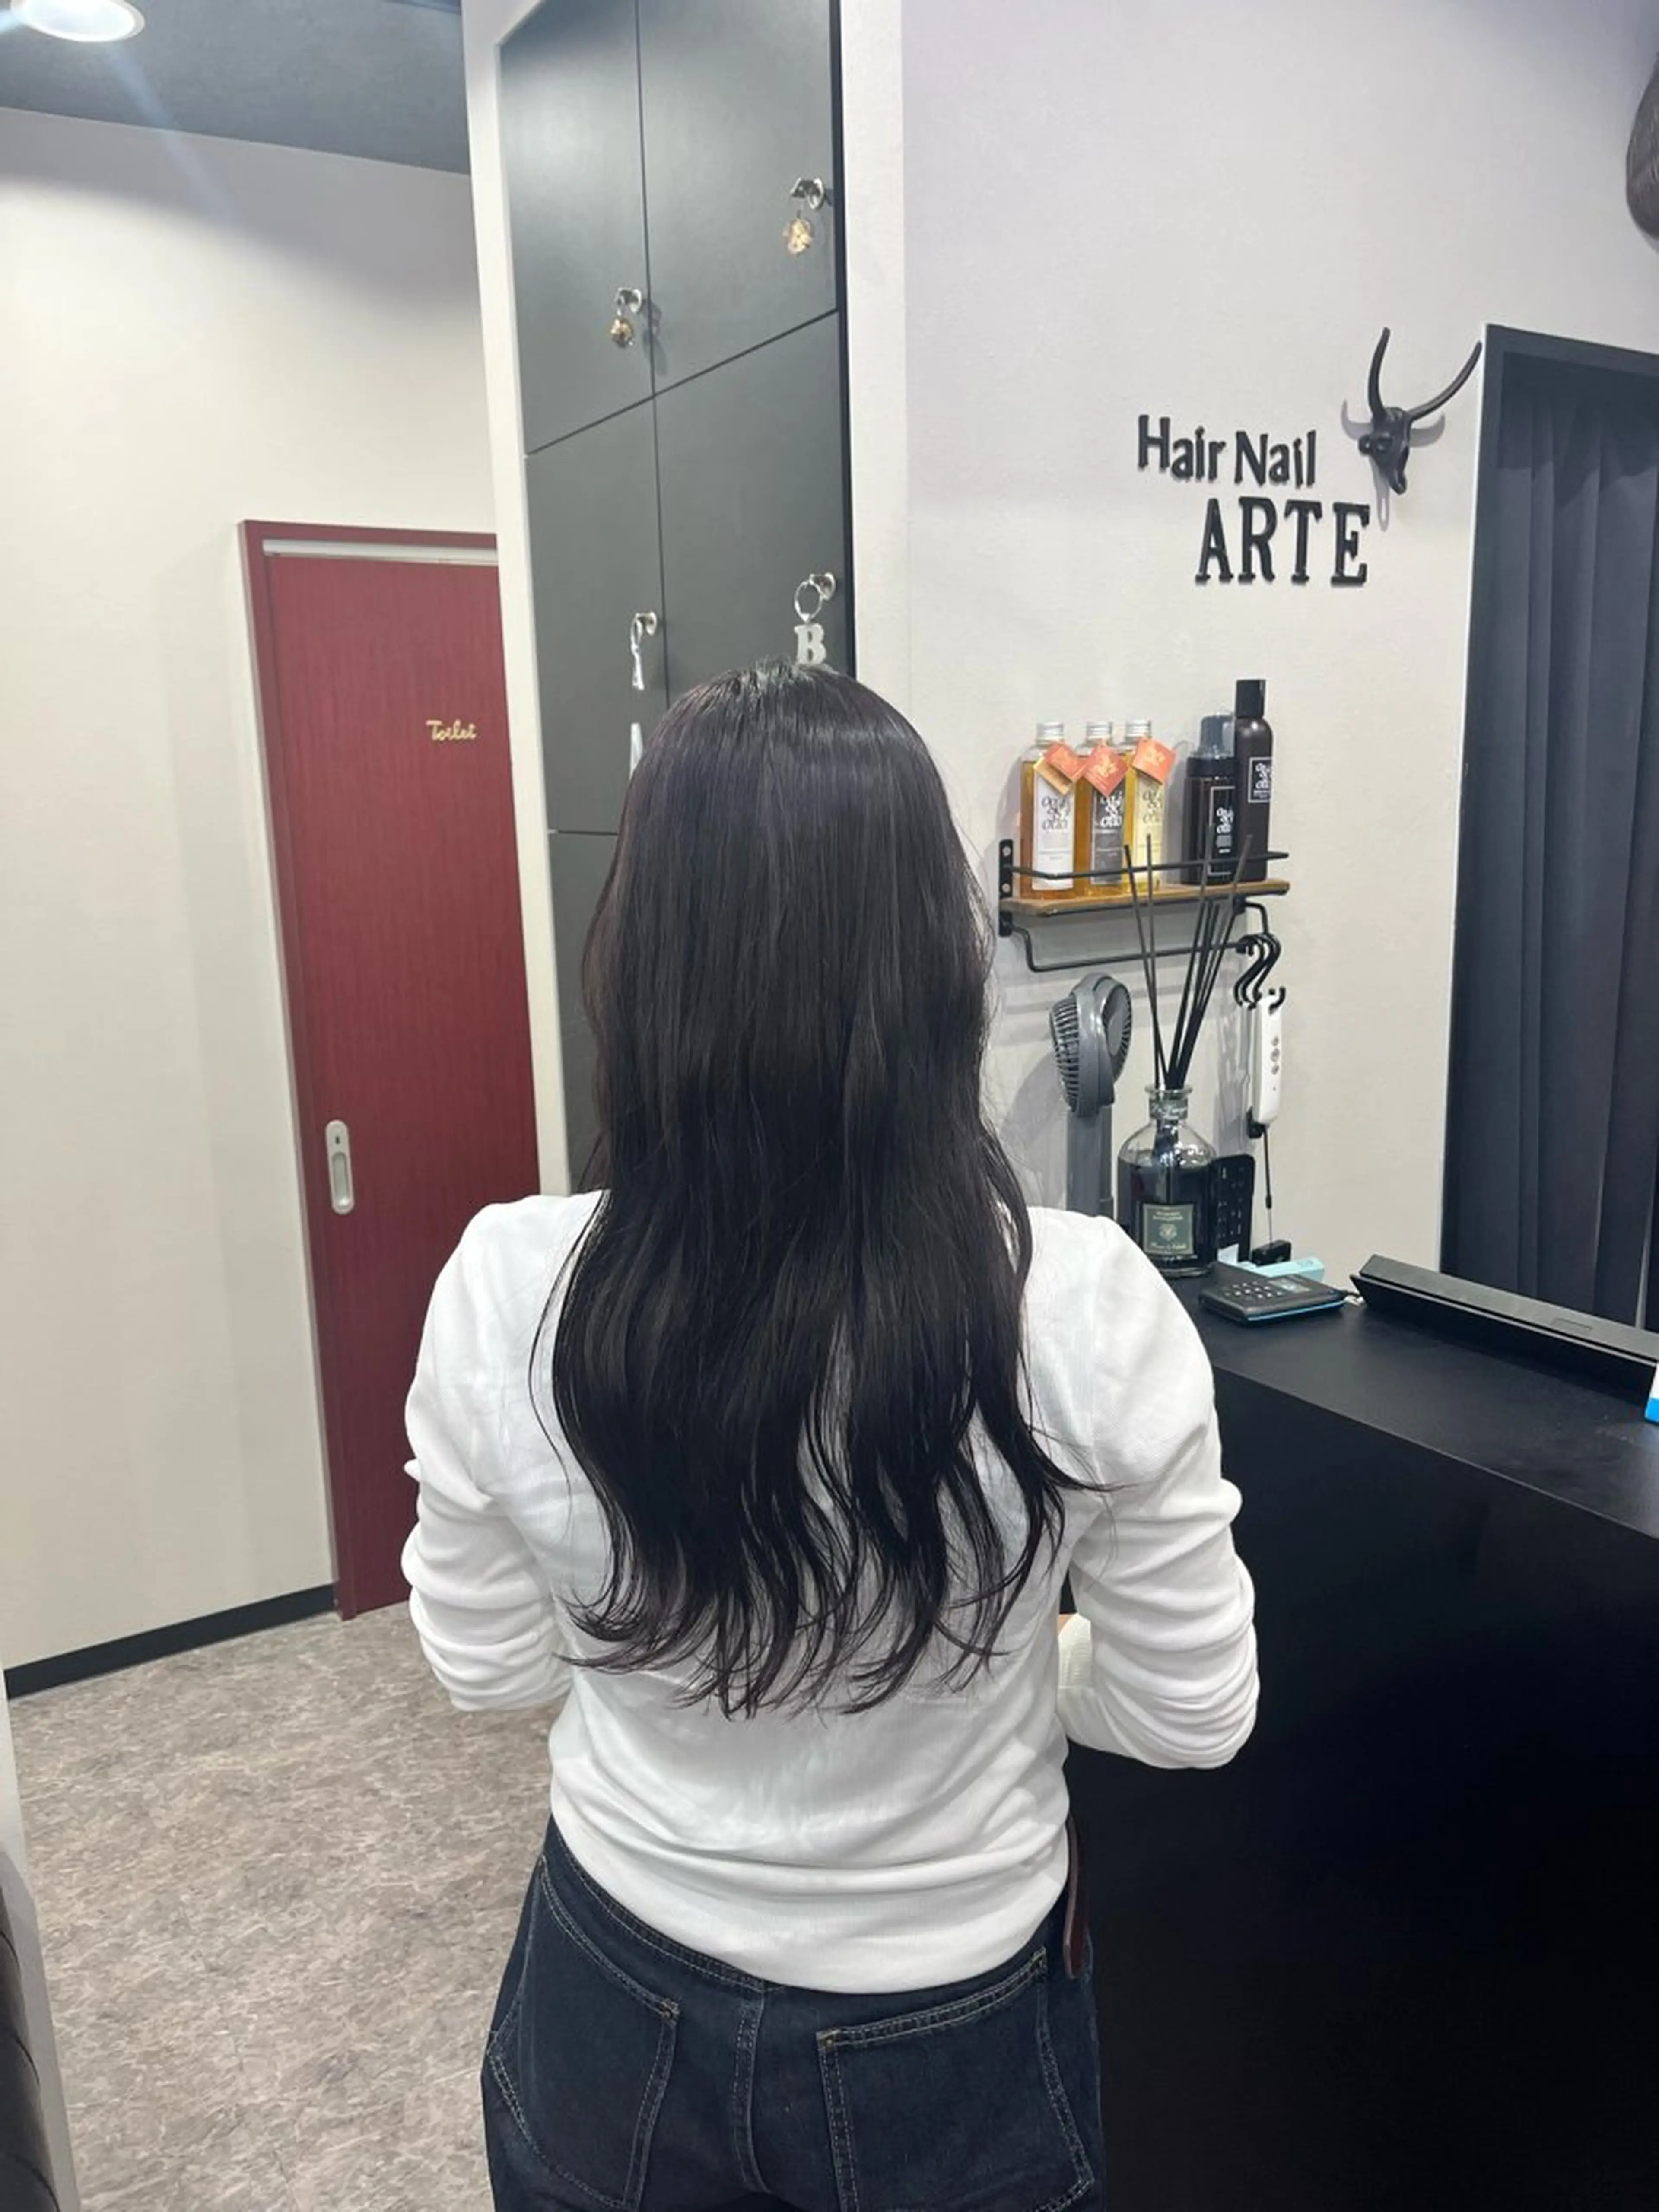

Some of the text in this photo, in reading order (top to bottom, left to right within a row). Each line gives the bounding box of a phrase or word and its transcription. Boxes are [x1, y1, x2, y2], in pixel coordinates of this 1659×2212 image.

[1138, 414, 1316, 488] Hair Nail
[1195, 496, 1370, 585] ARTE
[794, 623, 827, 666] B
[426, 719, 477, 741] Toilet
